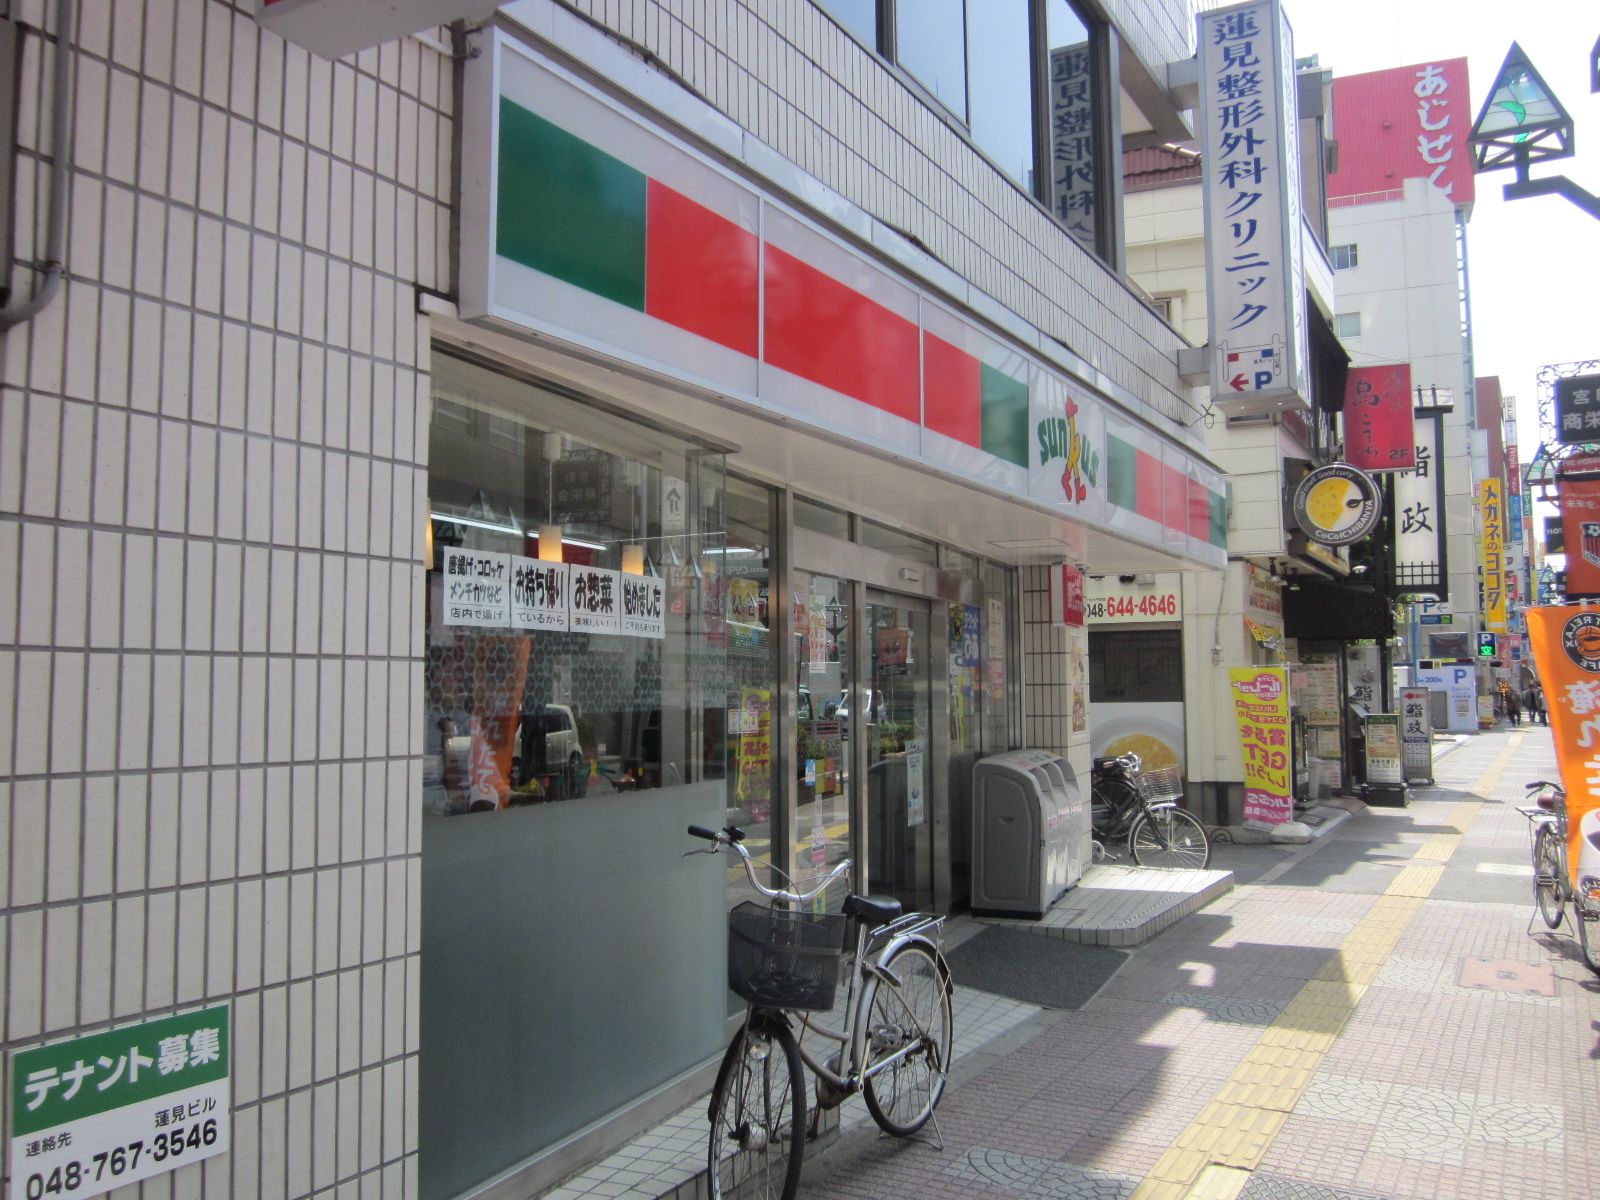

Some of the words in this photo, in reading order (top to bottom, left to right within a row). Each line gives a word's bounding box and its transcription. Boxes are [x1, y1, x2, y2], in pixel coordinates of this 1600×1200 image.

[1212, 10, 1271, 331] 蓮見整形外科クリニック
[1255, 371, 1272, 390] P
[1572, 388, 1600, 405] 宮
[1389, 448, 1409, 461] 2F
[1315, 499, 1374, 540] CoCoICHIBANYA
[1484, 485, 1502, 610] メガネのヨコタ
[450, 583, 503, 605] メンチカツなど
[515, 564, 564, 608] お持ち帰り
[575, 573, 613, 613] お惣菜
[624, 579, 661, 618] 始めました
[450, 607, 504, 621] 店内で揚げ
[517, 612, 564, 625] ているから
[1481, 634, 1492, 644] P
[1454, 669, 1467, 685] P
[1405, 702, 1426, 735] 鮨政
[25, 1027, 220, 1112] テナント募集
[155, 1096, 217, 1128] 蓮見ビル
[25, 1131, 73, 1158] 連絡先
